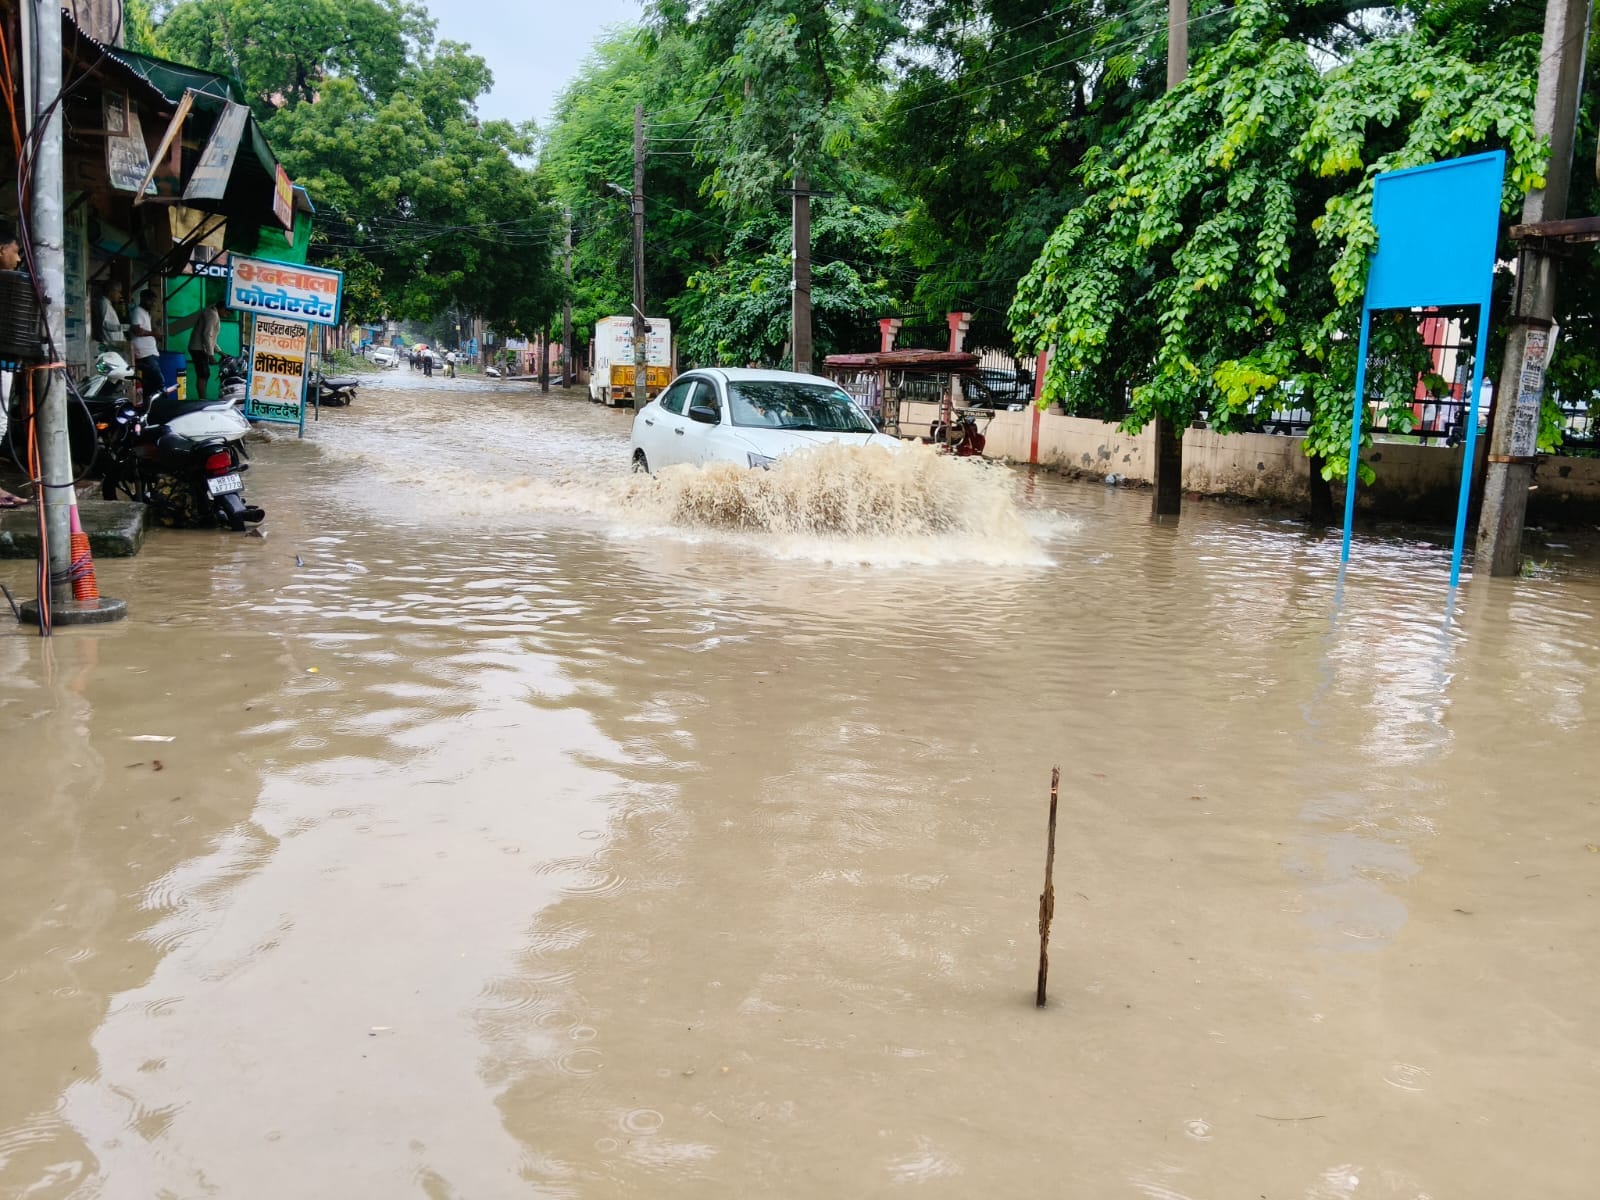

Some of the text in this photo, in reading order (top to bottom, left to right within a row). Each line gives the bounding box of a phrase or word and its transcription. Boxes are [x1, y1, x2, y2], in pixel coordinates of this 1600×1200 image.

[235, 285, 334, 318] फोटोस्टेट
[254, 352, 303, 377] लैमिनेशन
[251, 375, 298, 400] FAX
